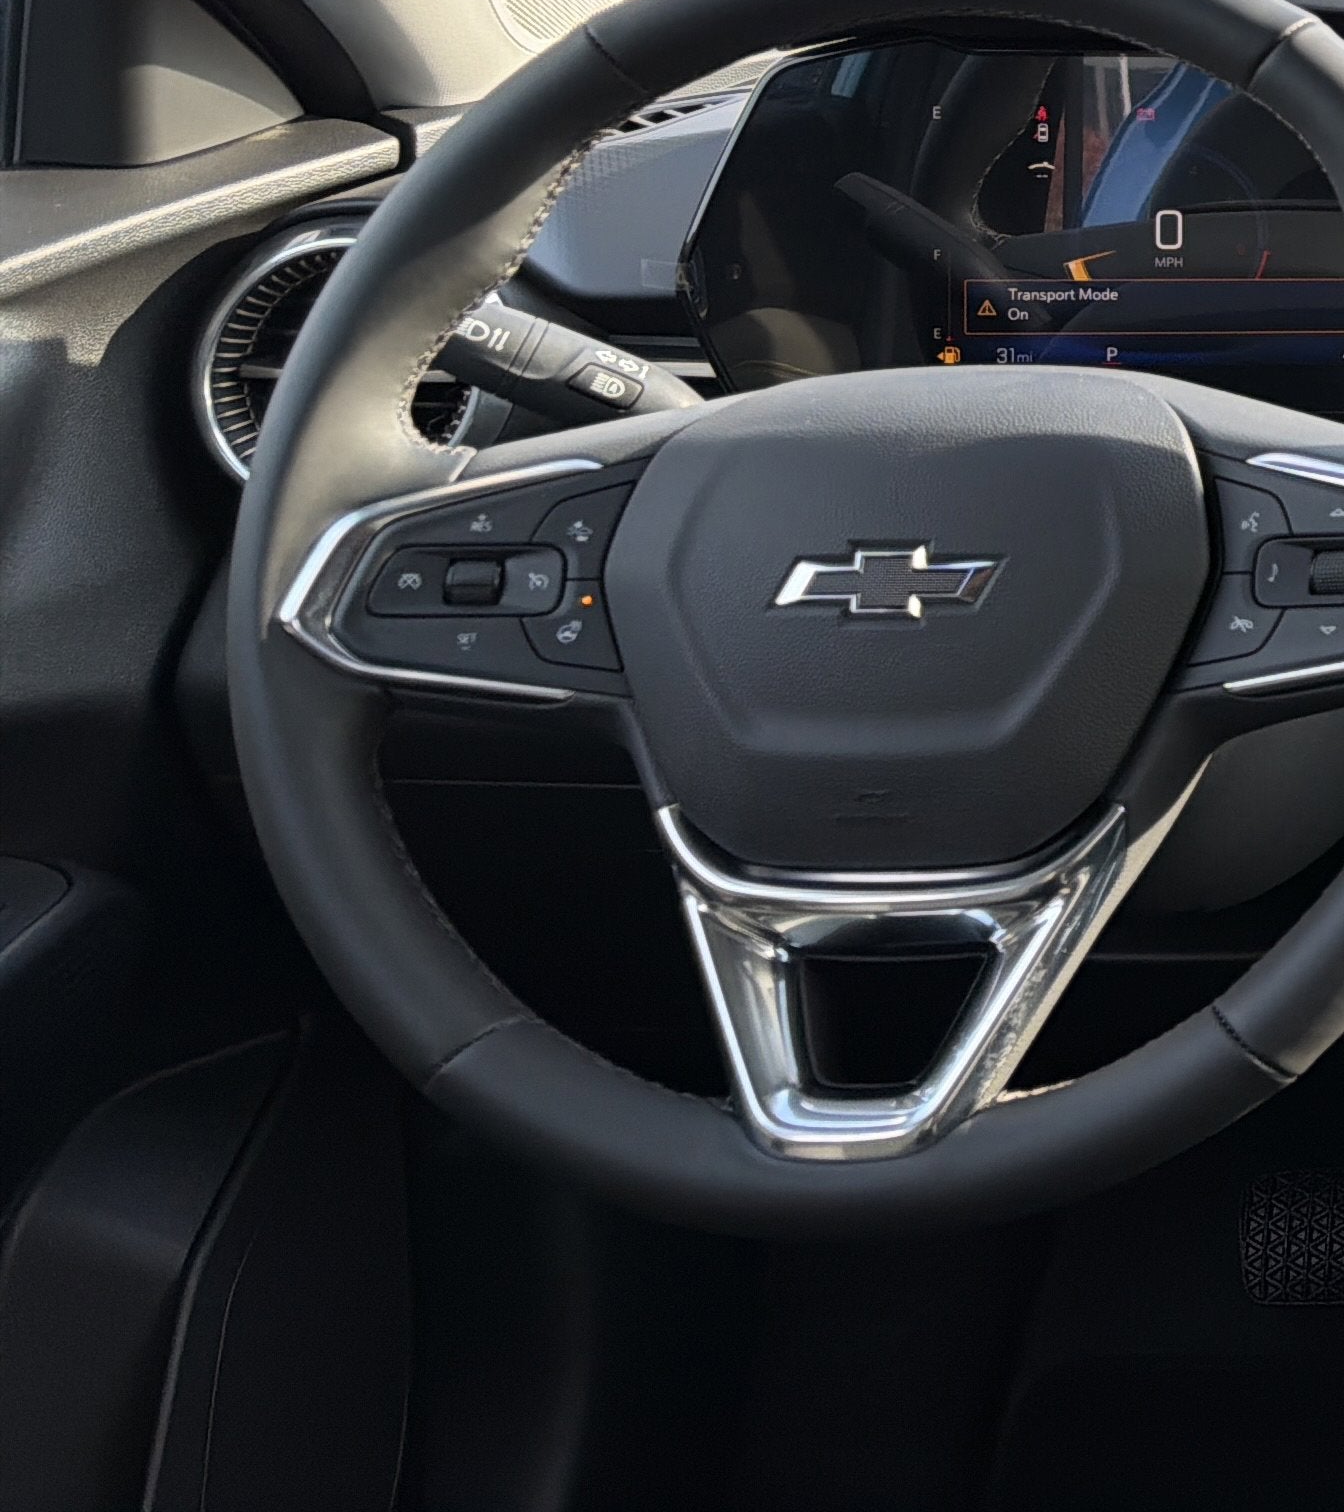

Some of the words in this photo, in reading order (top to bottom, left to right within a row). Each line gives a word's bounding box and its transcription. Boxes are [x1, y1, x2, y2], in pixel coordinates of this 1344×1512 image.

[1154, 256, 1184, 269] MPH
[1007, 288, 1076, 304] Transport
[1079, 288, 1119, 302] Mode
[1007, 308, 1029, 322] On
[933, 327, 941, 340] E
[1106, 346, 1119, 362] P
